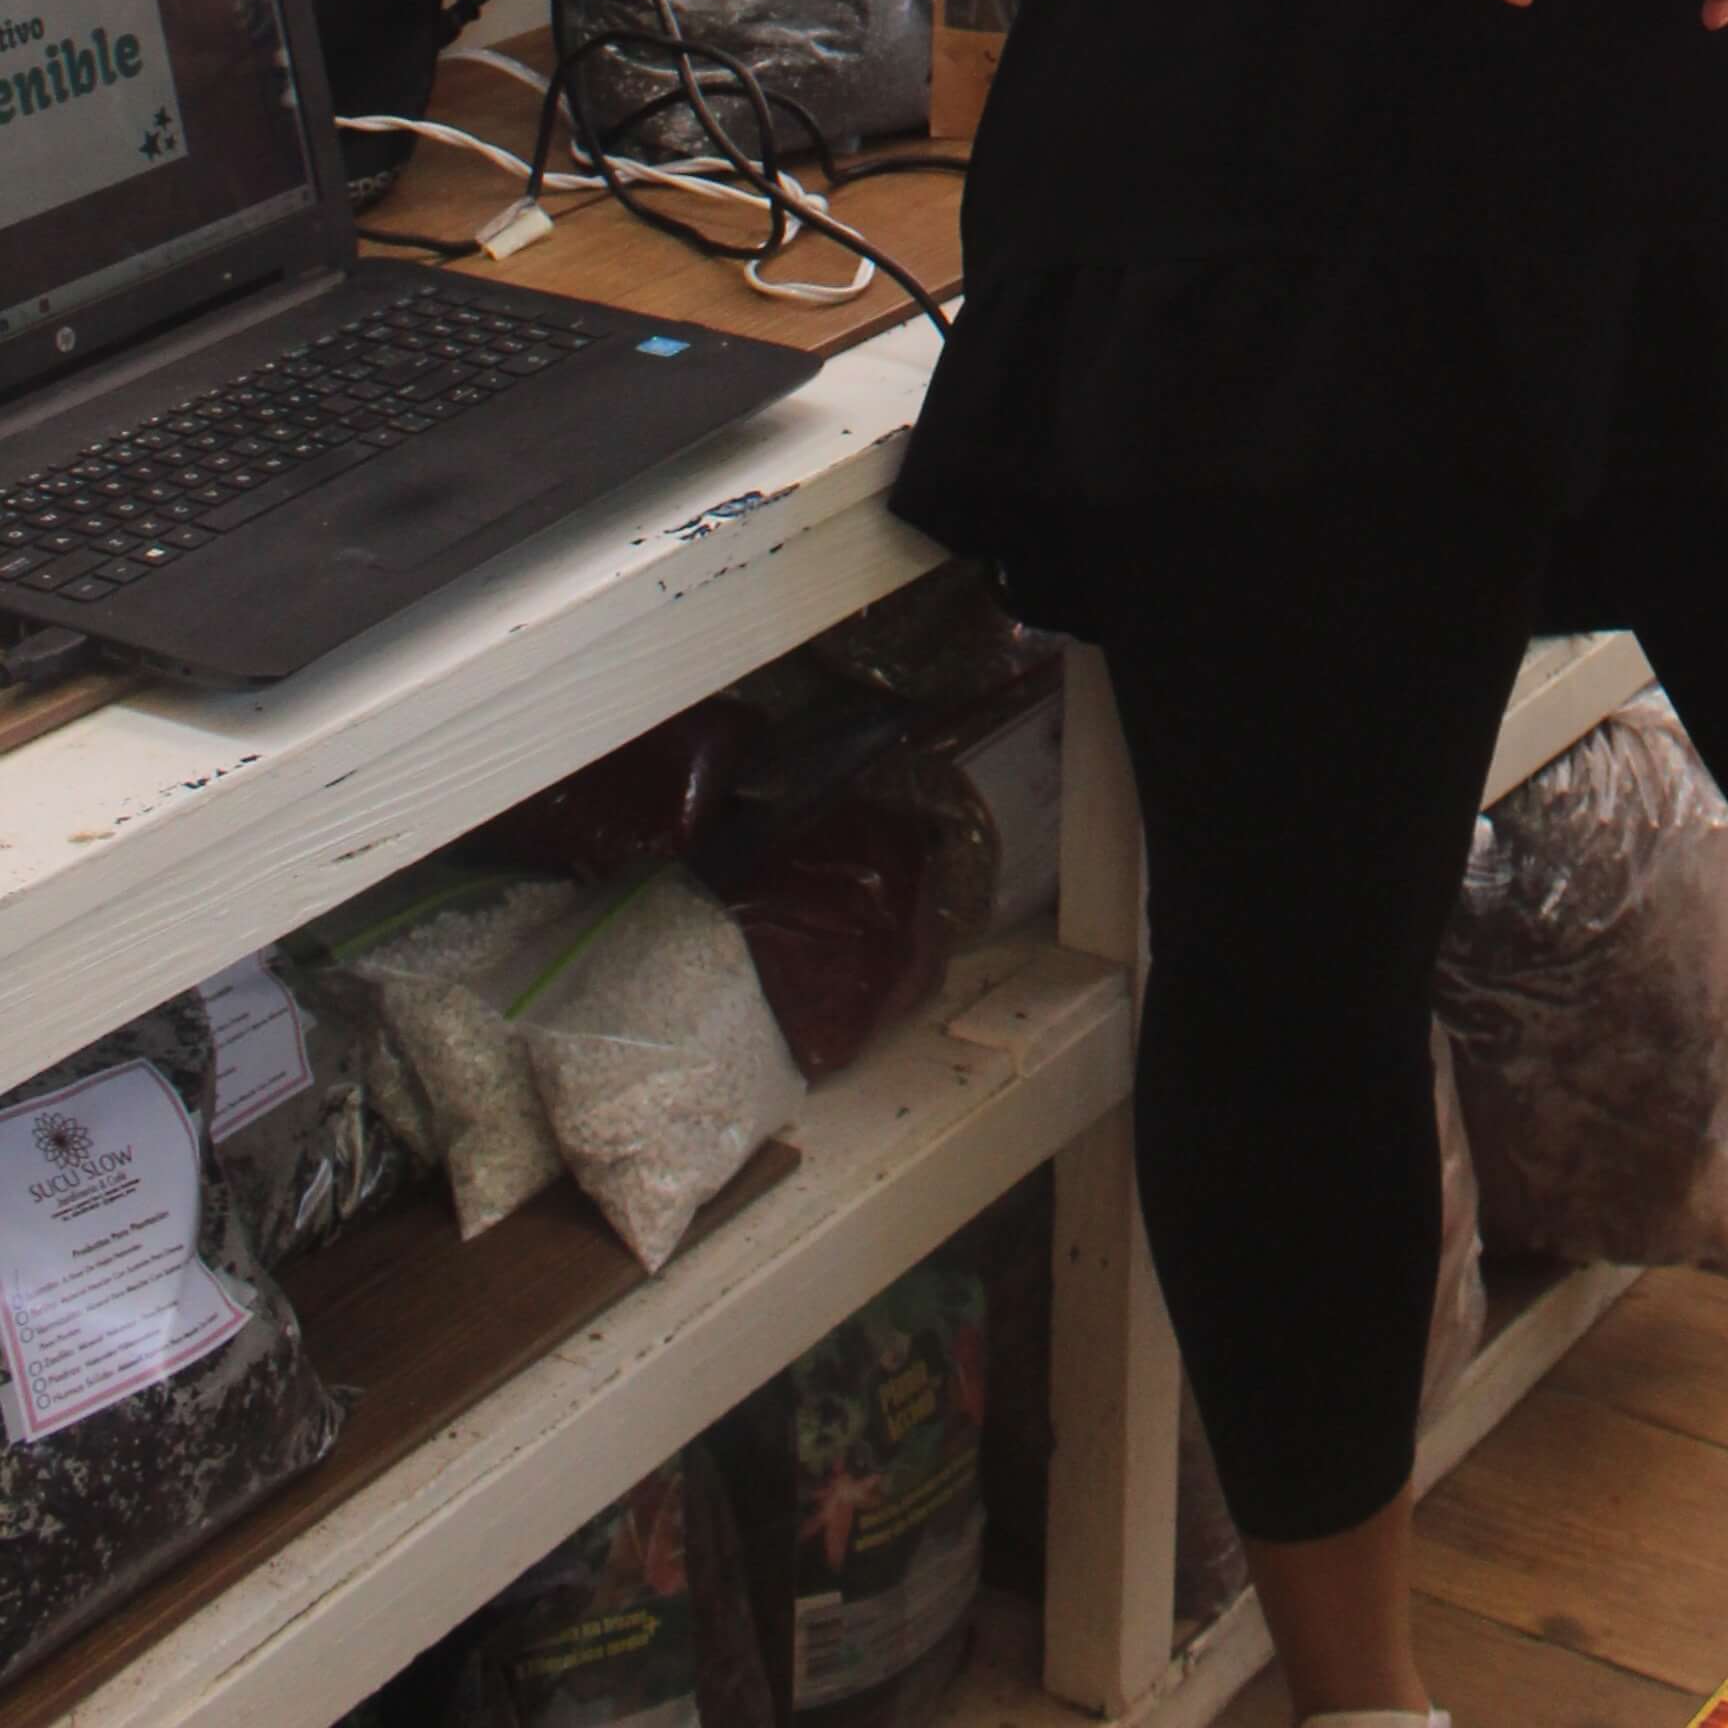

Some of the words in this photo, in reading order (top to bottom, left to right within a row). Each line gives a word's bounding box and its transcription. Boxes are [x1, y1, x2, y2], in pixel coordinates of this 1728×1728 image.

[0, 26, 144, 125] enible
[29, 1168, 81, 1203] SUCU
[81, 1144, 133, 1181] SLOW
